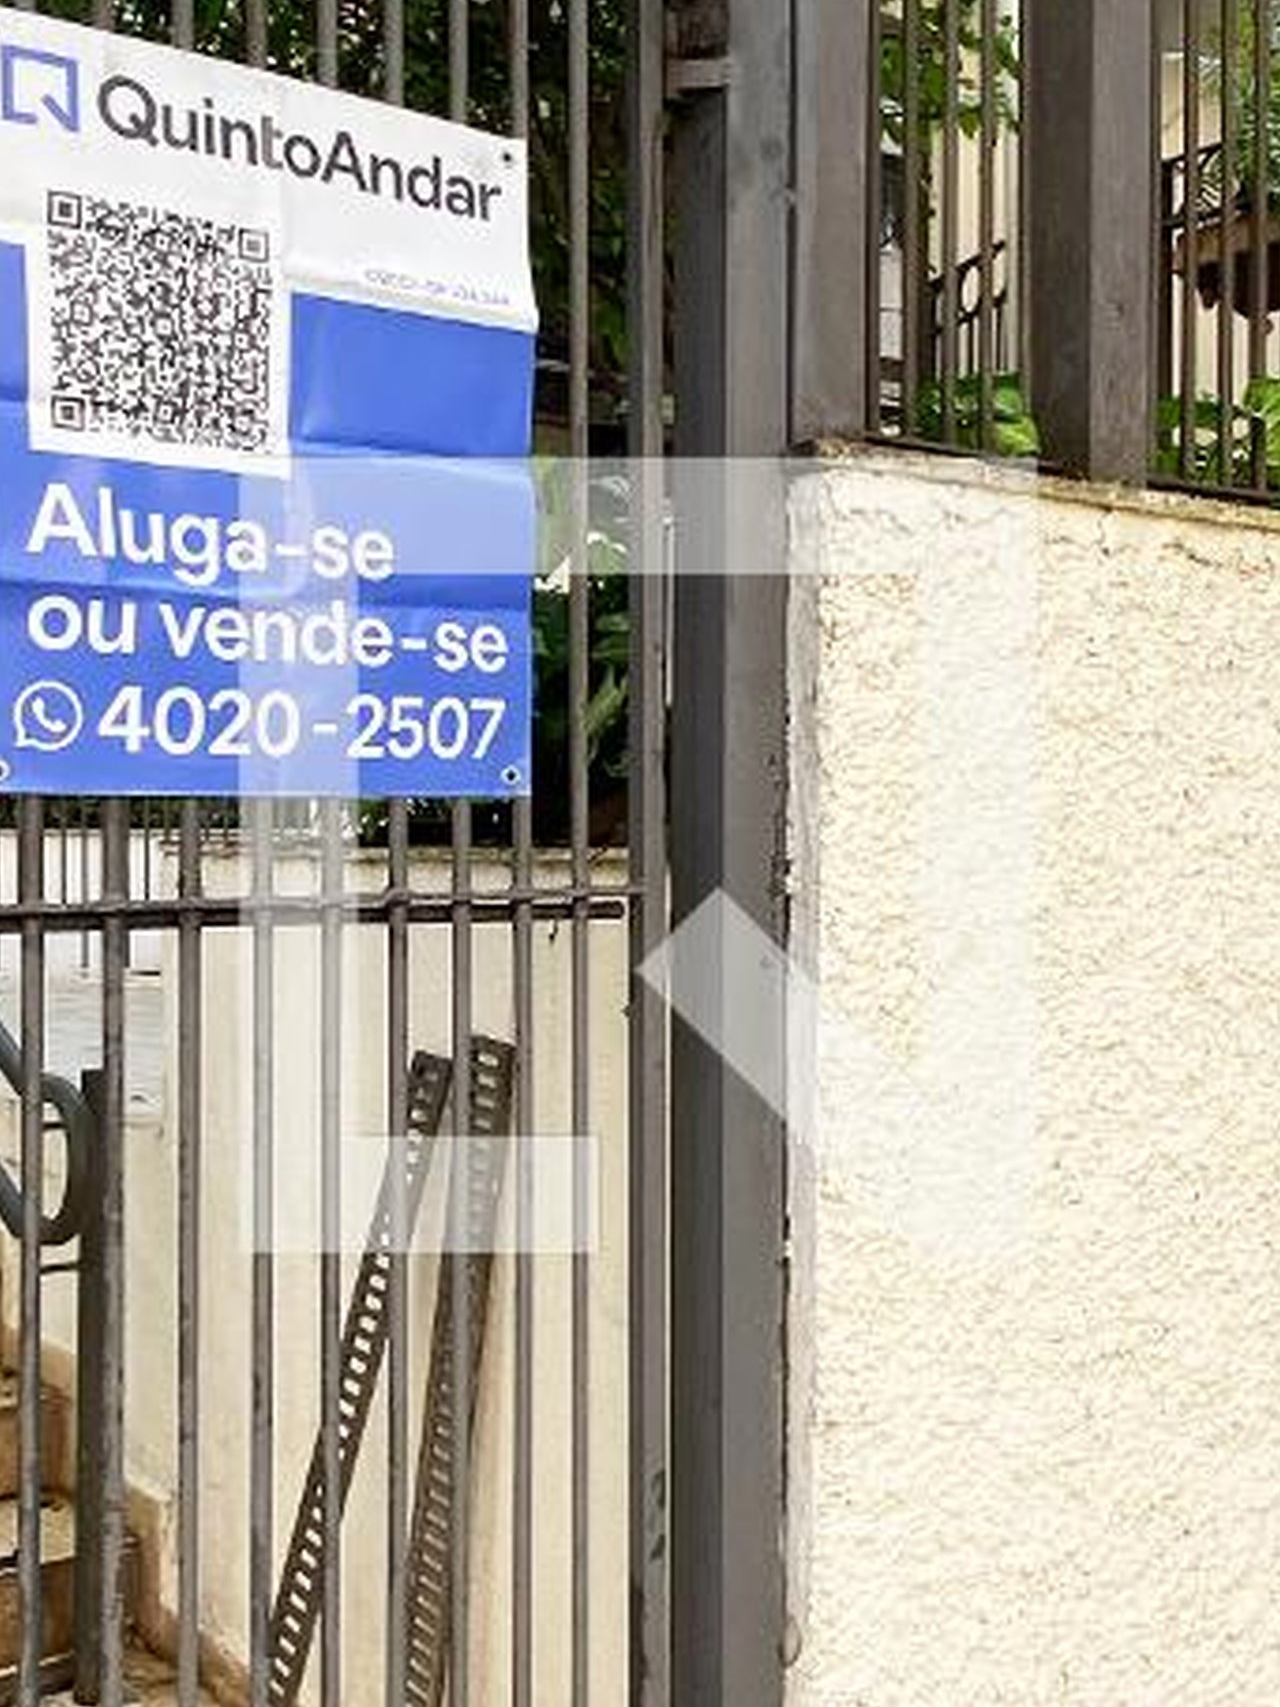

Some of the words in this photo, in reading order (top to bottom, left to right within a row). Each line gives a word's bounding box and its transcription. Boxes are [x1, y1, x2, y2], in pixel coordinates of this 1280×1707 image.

[97, 74, 503, 224] QuintoAndar
[25, 482, 396, 588] Aluga-se
[26, 595, 135, 655] ou
[162, 595, 510, 675] vende-se
[96, 685, 506, 762] 4020-2507
